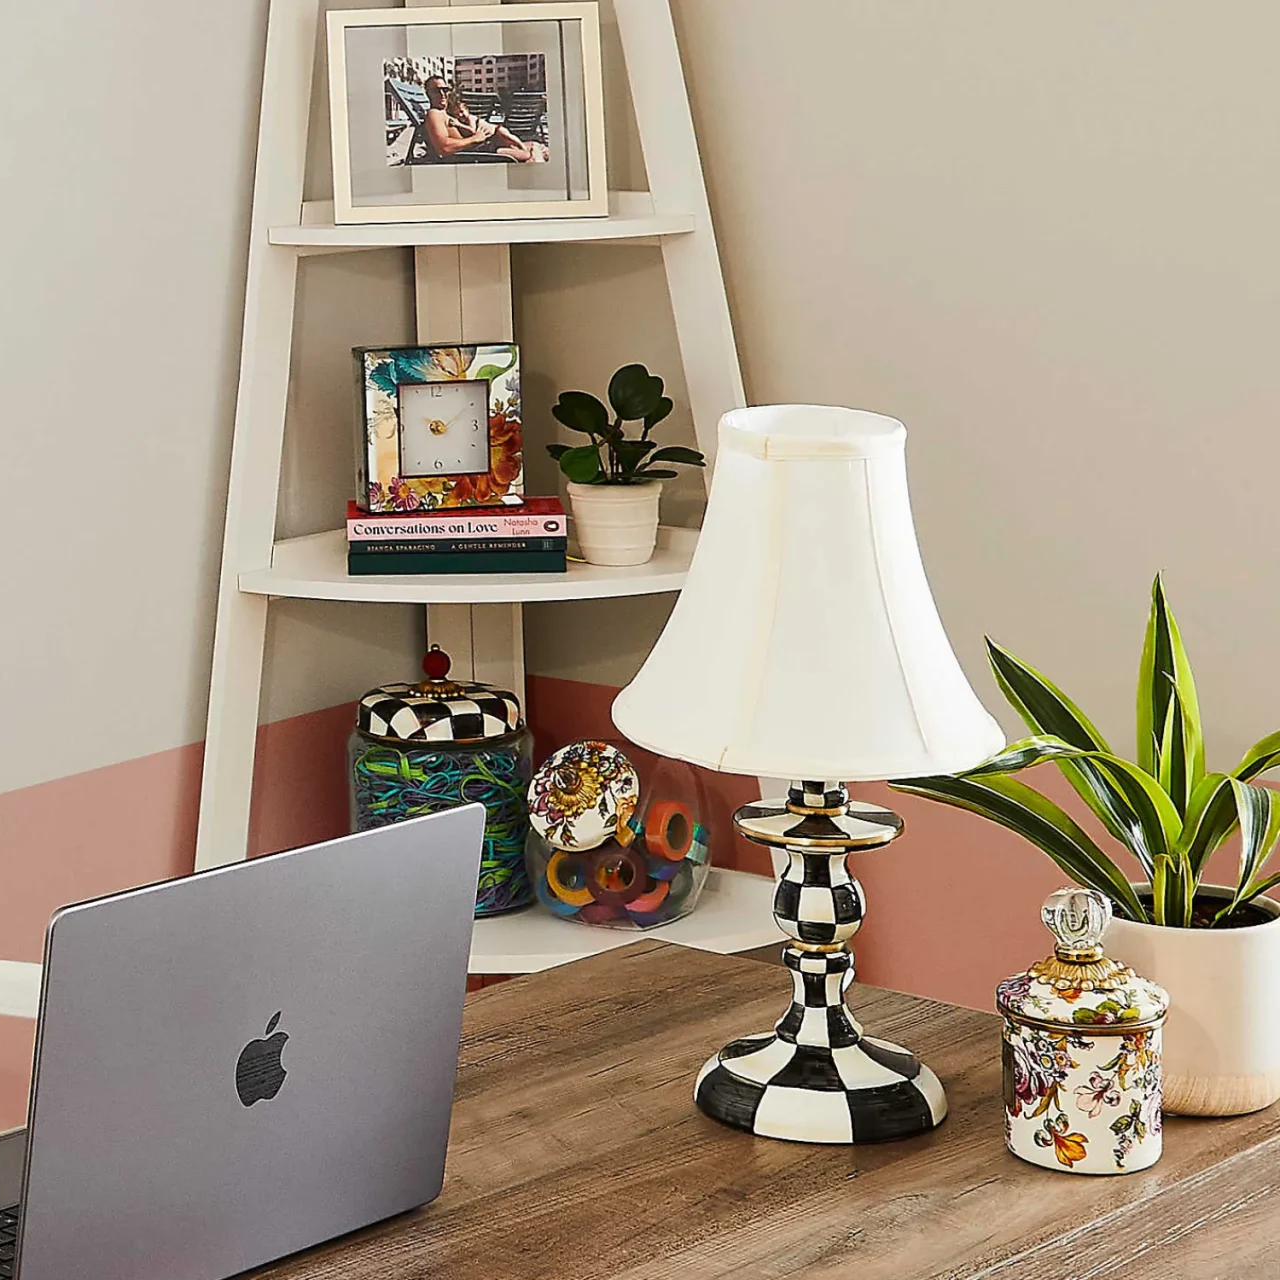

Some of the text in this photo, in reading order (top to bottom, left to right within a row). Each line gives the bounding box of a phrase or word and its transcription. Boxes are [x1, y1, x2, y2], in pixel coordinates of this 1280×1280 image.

[430, 386, 442, 397] 12
[472, 419, 479, 431] 3
[434, 459, 443, 469] 6
[503, 518, 538, 527] Natasha
[353, 522, 498, 535] Conversations on Love
